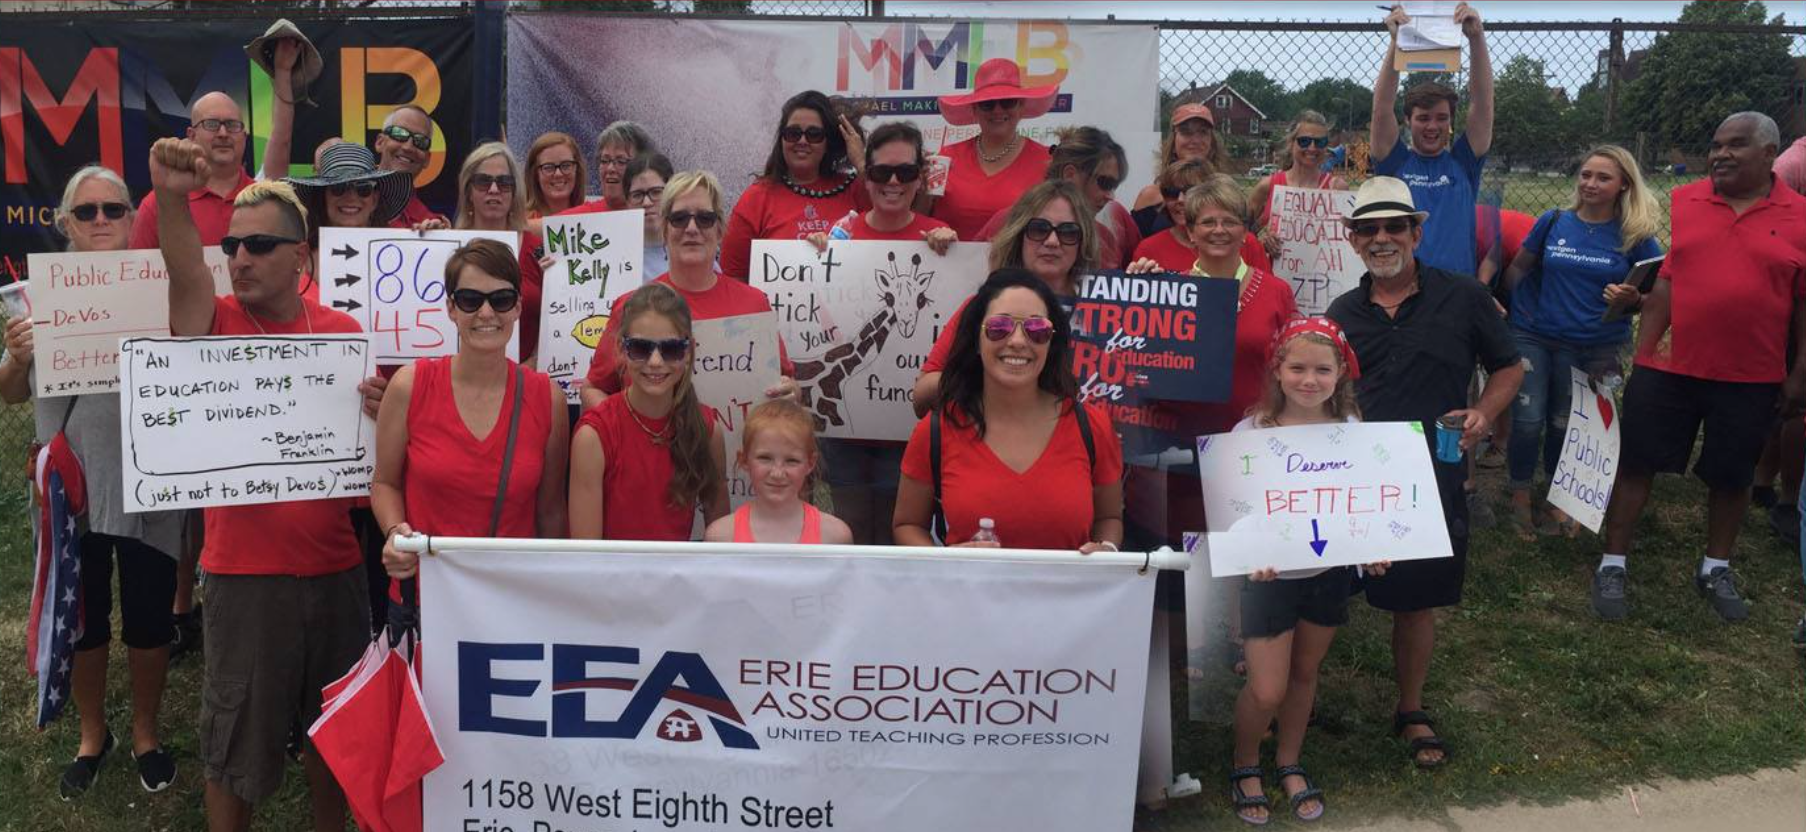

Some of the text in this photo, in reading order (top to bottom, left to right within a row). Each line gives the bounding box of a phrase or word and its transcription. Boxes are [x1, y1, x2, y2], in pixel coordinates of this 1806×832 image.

[1284, 191, 1342, 217] EQUAL
[546, 222, 610, 256] Mike
[798, 219, 830, 231] KEEP
[50, 262, 112, 289] Public
[375, 243, 446, 304] 86
[567, 259, 633, 299] Kelly is
[763, 247, 842, 284] Don't
[1075, 275, 1198, 308] TANDING
[771, 293, 822, 324] tick
[374, 308, 445, 352] 45
[553, 330, 562, 339] a
[800, 324, 839, 352] your
[1104, 328, 1147, 353] for
[53, 349, 120, 371] Better
[342, 344, 361, 357] IN
[548, 355, 579, 374] dont
[139, 380, 240, 398] EDUCATION
[304, 374, 335, 387] THE
[1574, 380, 1589, 420] I
[280, 444, 336, 460] Franklin
[1239, 453, 1259, 475] I
[1286, 452, 1355, 474] Deserve
[1565, 427, 1612, 477] Public
[188, 480, 211, 500] not
[220, 481, 238, 499] to
[739, 658, 1118, 695] ERIE EDUCATION
[457, 640, 761, 750] EEA
[751, 692, 1059, 726] ASSOCIATION
[766, 726, 1111, 747] UNITED TEACHING PROFESSION
[462, 778, 834, 830] 1158 West Eighth Street
